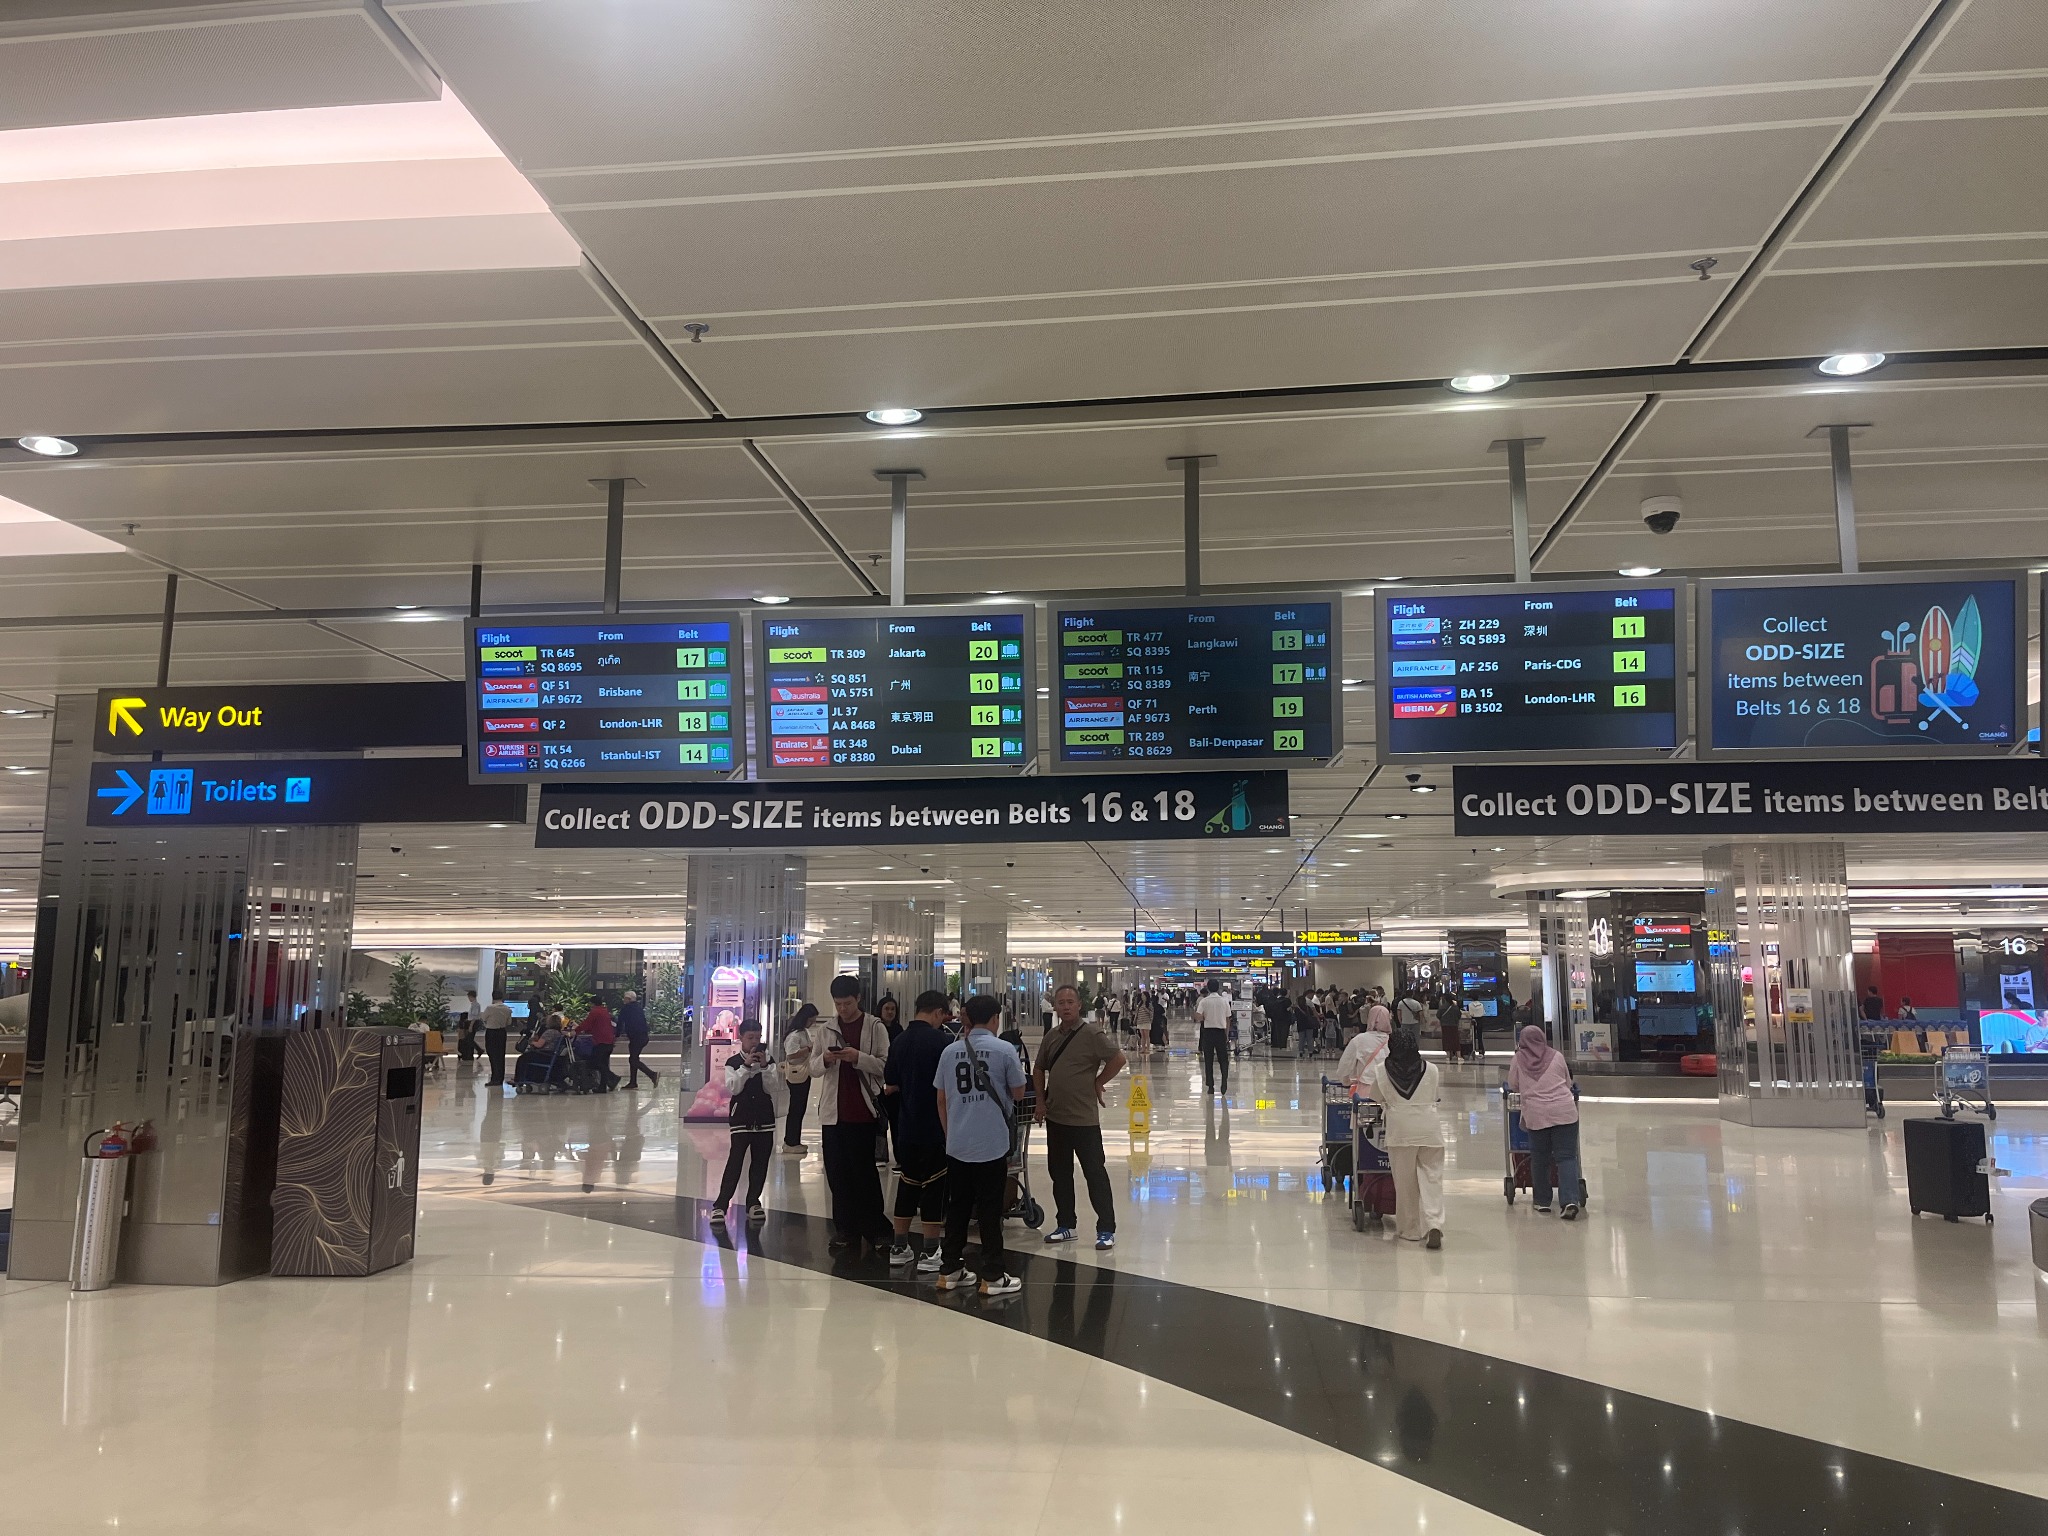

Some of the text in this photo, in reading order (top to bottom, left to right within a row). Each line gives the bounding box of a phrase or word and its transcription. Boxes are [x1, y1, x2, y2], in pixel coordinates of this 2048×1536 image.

[1525, 601, 1553, 610] From
[1615, 597, 1637, 607] Belt
[1394, 604, 1425, 616] Flight
[1275, 611, 1295, 620] Belt
[972, 622, 991, 631] Belt
[1065, 617, 1094, 628] Flight
[1459, 619, 1499, 629] ZH 229
[1764, 617, 1827, 633] Collect
[770, 626, 799, 637] Flight
[890, 624, 915, 632] From
[1524, 625, 1547, 636] 深圳
[1621, 623, 1635, 635] 11
[599, 632, 623, 640] From
[679, 630, 698, 638] Belt
[1078, 633, 1107, 642] scoot
[1127, 632, 1162, 641] TR 477
[482, 634, 510, 645] Flight
[1188, 638, 1237, 650] Langkawi
[1280, 636, 1295, 648] 13
[1460, 634, 1505, 645] SQ 5893
[495, 650, 523, 658] scoot
[540, 649, 574, 657] TR 645
[784, 651, 812, 659] scoot
[830, 650, 865, 658] TR 309
[889, 648, 925, 657] Jakarta
[976, 647, 992, 658] 20
[1127, 647, 1170, 656] SQ 8395
[1746, 643, 1844, 660] ODD-SIZE
[684, 654, 698, 665] 17
[1525, 659, 1581, 670] Paris-CDG
[1621, 658, 1638, 669] 14
[541, 663, 582, 672] SQ 8695
[1078, 666, 1108, 675] scoot
[1127, 666, 1163, 675] TR 115
[1460, 662, 1498, 672] AF 256
[831, 674, 866, 684] SQ 851
[1189, 671, 1210, 682] 南宁
[1280, 670, 1296, 681] 17
[1729, 672, 1862, 688] items between
[542, 681, 569, 691] QF 51
[890, 680, 910, 690] 广州
[977, 679, 992, 690] 10
[1128, 680, 1171, 690] SQ 8389
[599, 687, 642, 696] Brisbane
[685, 686, 698, 697] 11
[831, 688, 873, 697] VA 5751
[1461, 688, 1493, 698] BA 15
[542, 695, 582, 704] AF 9672
[1525, 693, 1595, 703] London-LHR
[1622, 692, 1638, 703] 16
[1128, 699, 1156, 709] QF 71
[1280, 703, 1296, 714] 19
[1461, 703, 1502, 713] IB 3502
[1737, 698, 1860, 715] Belts 16 & 18
[832, 707, 857, 716] JL 37
[1189, 705, 1216, 714] Perth
[160, 706, 262, 732] Way Out
[891, 712, 933, 722] 東京羽田
[978, 712, 993, 722] 16
[1128, 713, 1170, 722] AF 9673
[543, 720, 565, 730] QF 2
[600, 719, 662, 728] London-LHR
[686, 718, 701, 729] 18
[833, 721, 875, 730] AA 8468
[1080, 732, 1109, 741] scoot
[1128, 732, 1164, 741] TR 289
[776, 741, 808, 749] Emirates
[834, 740, 846, 748] EK
[849, 739, 867, 748] 348
[1190, 738, 1263, 748] Bali-Denpasar
[1280, 736, 1297, 748] 20
[544, 745, 572, 754] TK 54
[892, 745, 921, 754] Dubai
[979, 744, 994, 755] 12
[1129, 746, 1172, 756] SQ 8629
[601, 751, 661, 760] Istanbul-IST
[687, 750, 702, 760] 14
[834, 753, 875, 763] QF 8380
[544, 759, 585, 768] SQ 6266
[202, 780, 276, 801] Toilets
[1462, 793, 1556, 816] Collect
[1567, 783, 1752, 815] ODD-SIZE
[1765, 789, 1844, 812] items
[1854, 788, 1983, 811] between
[545, 790, 1195, 829] Collect ODD-SIZE items between Belts 16 & 18
[2000, 937, 2026, 955] 16
[1411, 965, 1431, 978] 16
